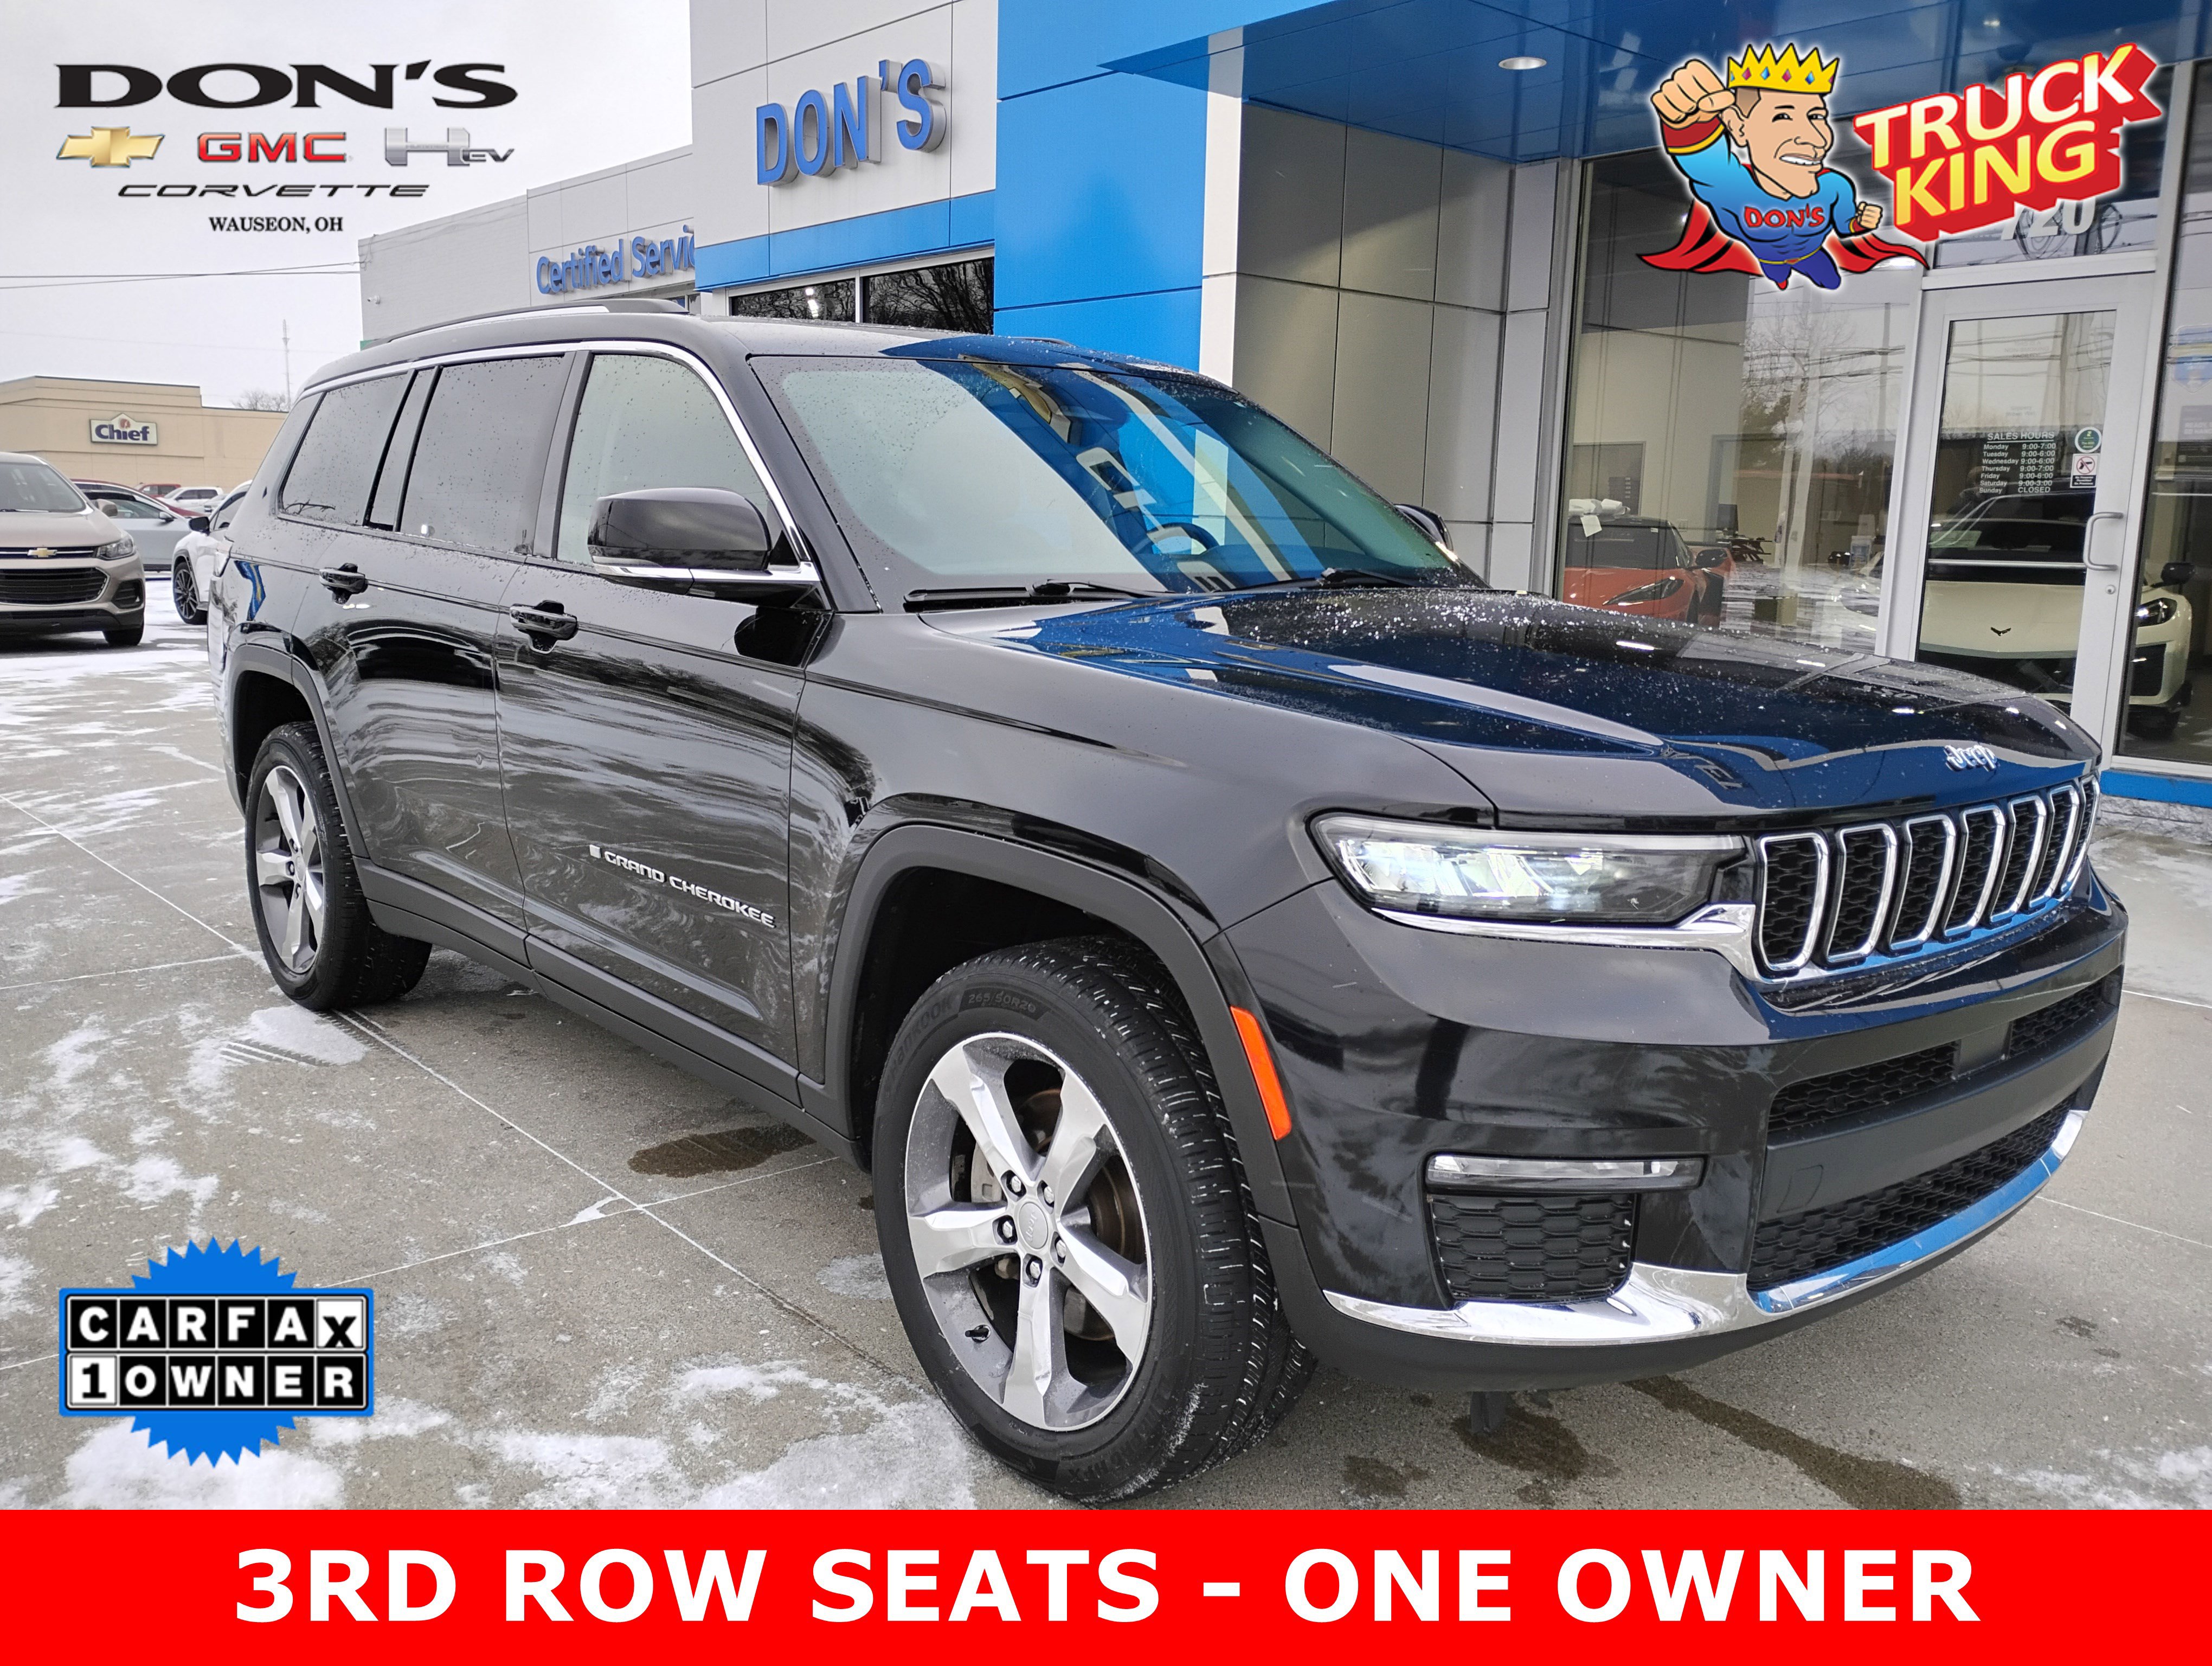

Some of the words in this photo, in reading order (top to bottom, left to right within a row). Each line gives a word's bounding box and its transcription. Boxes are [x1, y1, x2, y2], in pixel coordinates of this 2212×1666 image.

[756, 59, 944, 186] DON'S
[536, 239, 624, 294] Certified
[95, 424, 150, 441] Chief
[1988, 432, 2018, 440] SALES
[2021, 431, 2055, 439] HOURS
[605, 851, 665, 883] GRAND
[669, 876, 776, 928] CHEROKEE
